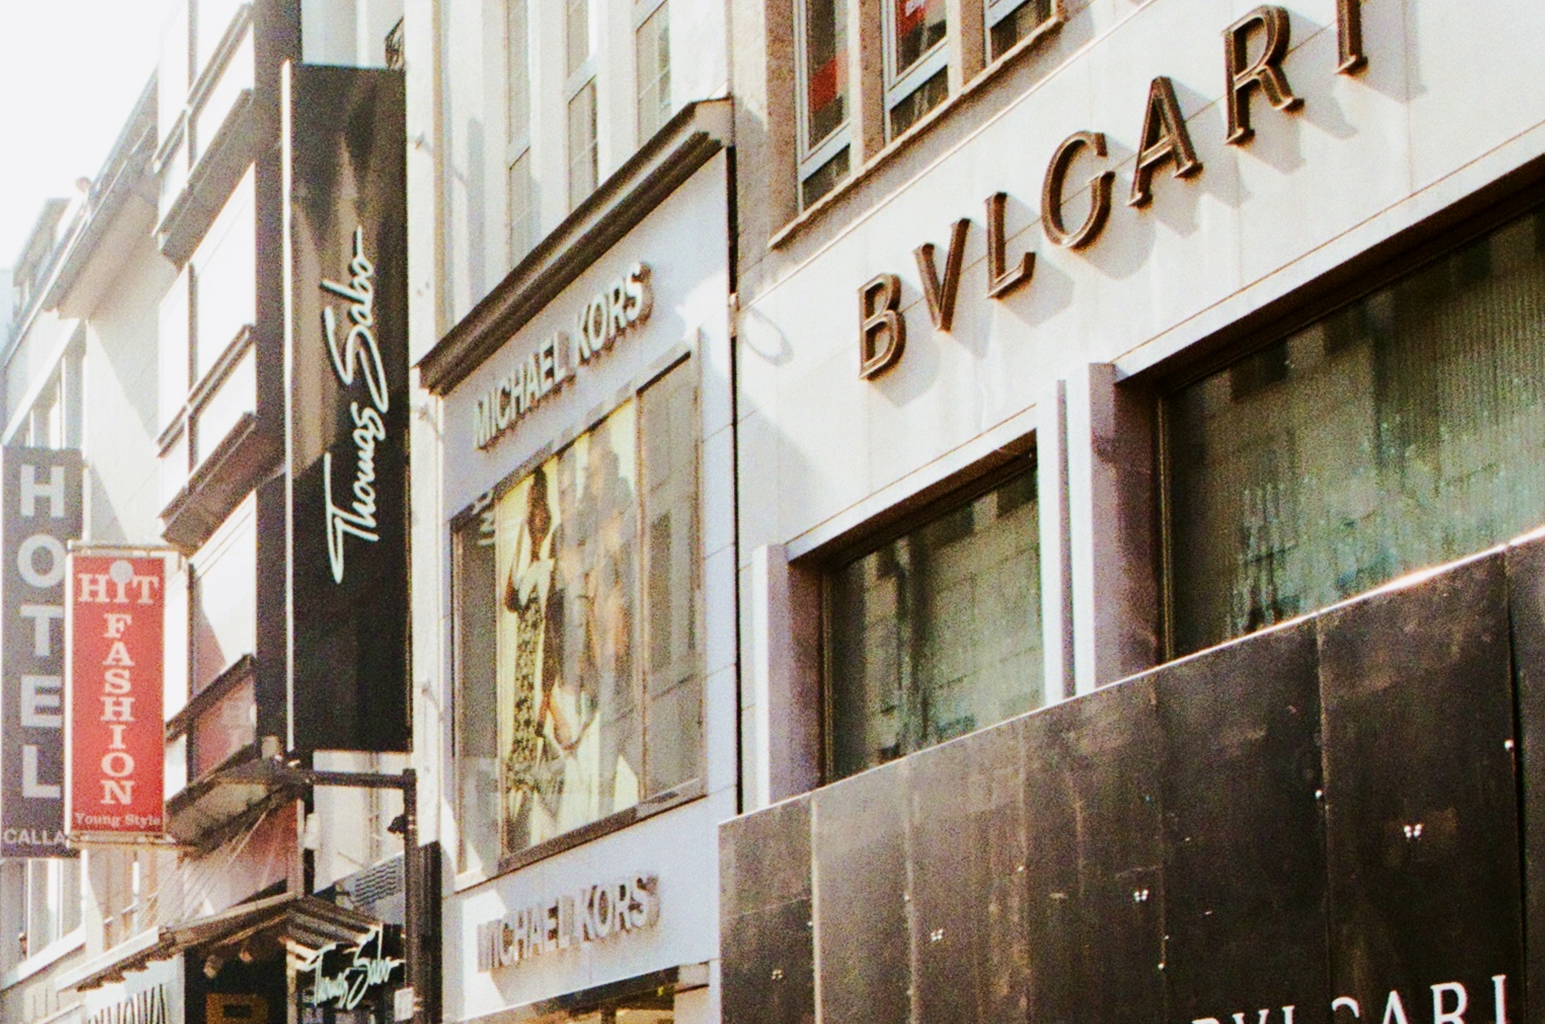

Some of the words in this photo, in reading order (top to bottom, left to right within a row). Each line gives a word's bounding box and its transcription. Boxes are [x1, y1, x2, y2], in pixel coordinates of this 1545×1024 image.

[320, 225, 389, 413] Sabo
[474, 331, 567, 450] MICHAEL
[572, 261, 649, 366] KORS
[77, 566, 159, 606] HIT
[324, 402, 386, 585] Thomas
[17, 463, 65, 800] HOTEL
[100, 613, 136, 805] FASHION
[74, 812, 122, 828] Young
[124, 812, 162, 829] Style
[476, 896, 571, 973] MICHAEL
[574, 872, 655, 945] KORS
